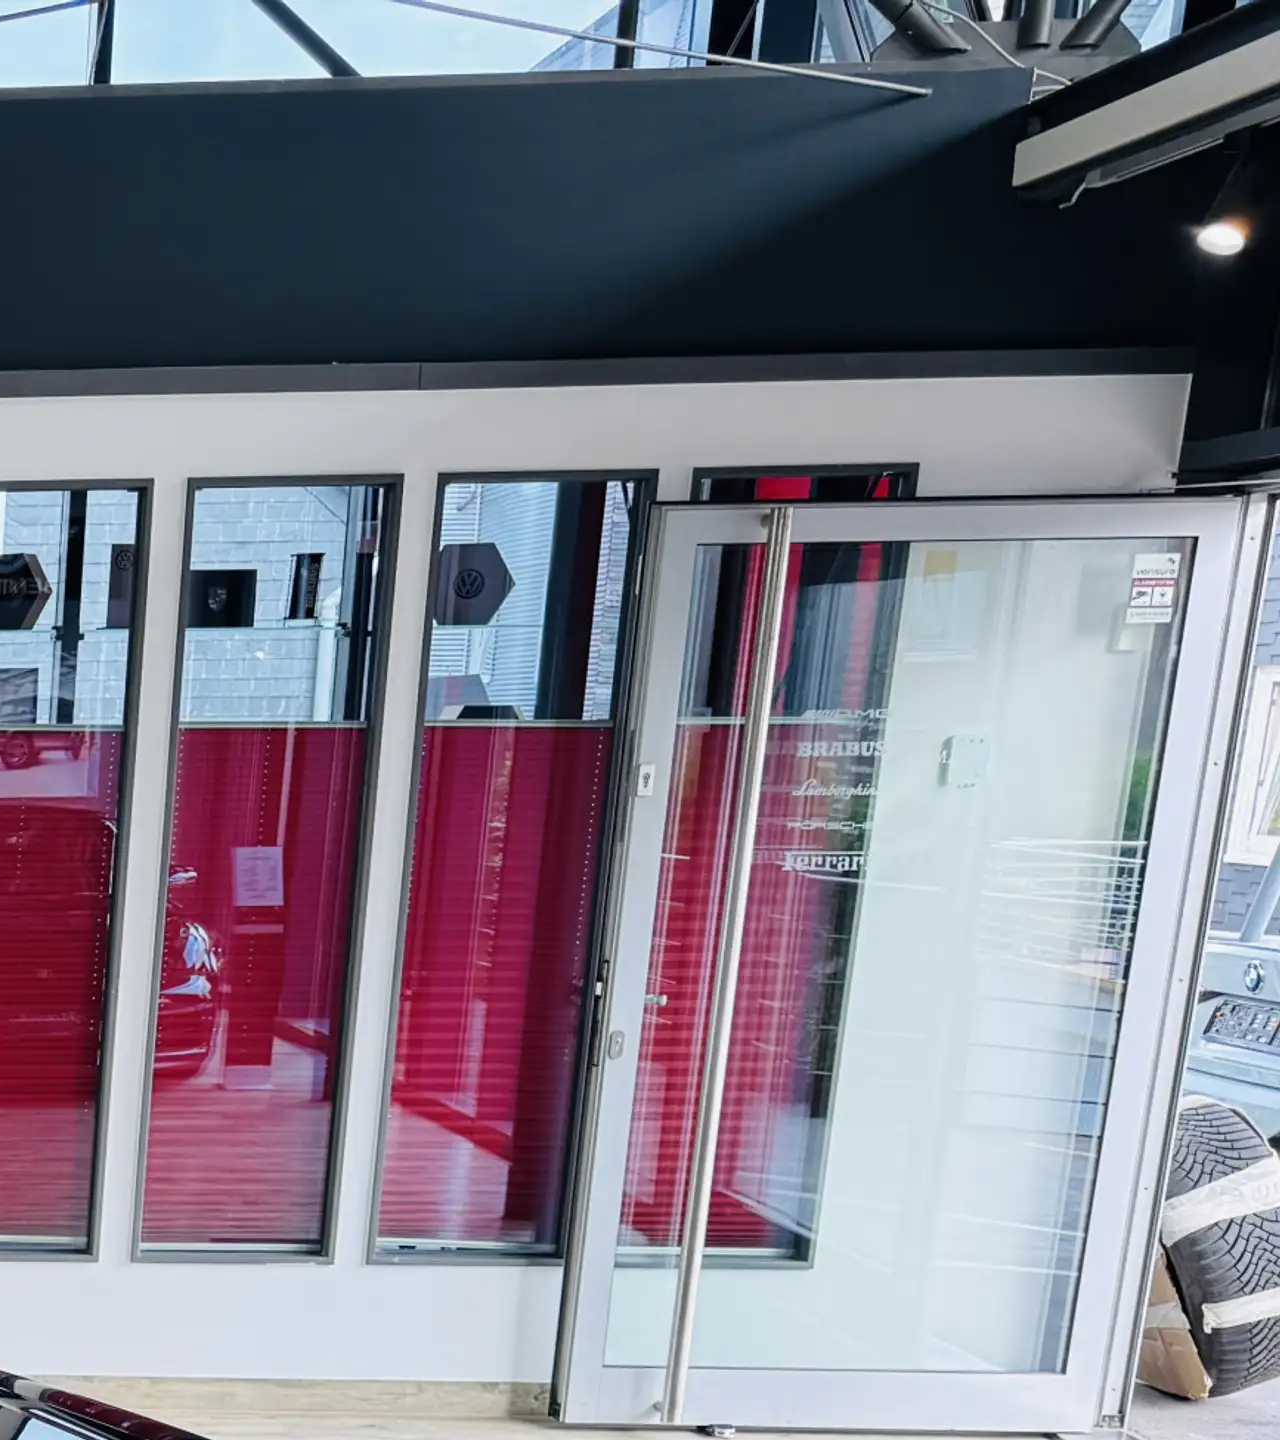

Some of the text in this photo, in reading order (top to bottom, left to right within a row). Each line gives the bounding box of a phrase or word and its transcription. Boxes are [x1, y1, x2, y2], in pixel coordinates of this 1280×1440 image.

[797, 741, 889, 758] BRABUS
[792, 778, 881, 800] Lamborghin
[787, 819, 874, 831] PORSCHE
[782, 851, 870, 873] Ferrar
